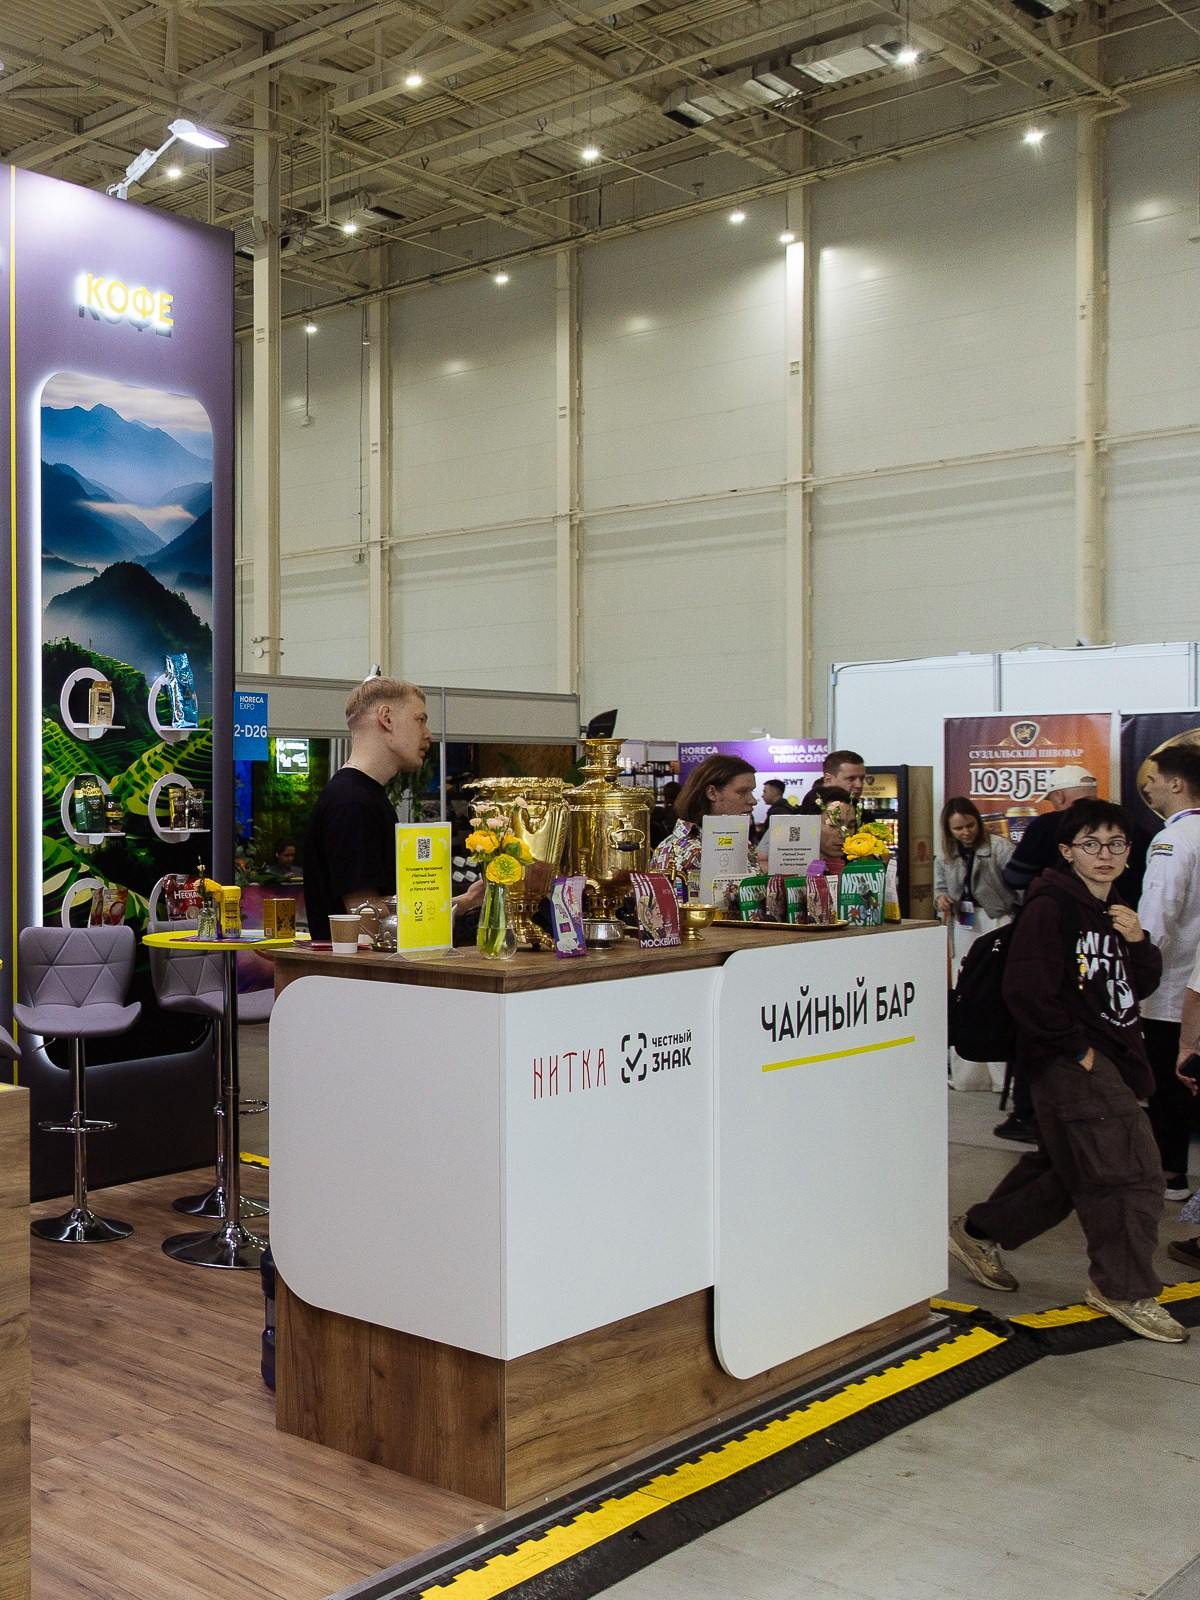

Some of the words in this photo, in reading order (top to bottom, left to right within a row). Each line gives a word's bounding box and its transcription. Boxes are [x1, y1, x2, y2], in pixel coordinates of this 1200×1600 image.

[87, 272, 174, 326] КОФЕ
[240, 695, 264, 704] HORECA
[240, 703, 255, 711] EXPO
[234, 724, 268, 738] 2-D26
[681, 746, 718, 755] HORECA
[768, 745, 807, 755] СЦЕНА
[969, 748, 1037, 758] СУЗДАЛЬСКИЙ
[1038, 749, 1084, 758] ПИВОВАР
[681, 755, 704, 763] EXPO
[968, 767, 1056, 802] ЮЗБЕ
[761, 976, 868, 1043] ЧАЙНЫЙ
[876, 982, 915, 1022] БАР
[652, 1029, 692, 1048] ЧЕСТНЫЙ
[652, 1047, 692, 1073] ЗНАК
[533, 1048, 607, 1099] НИТКА
